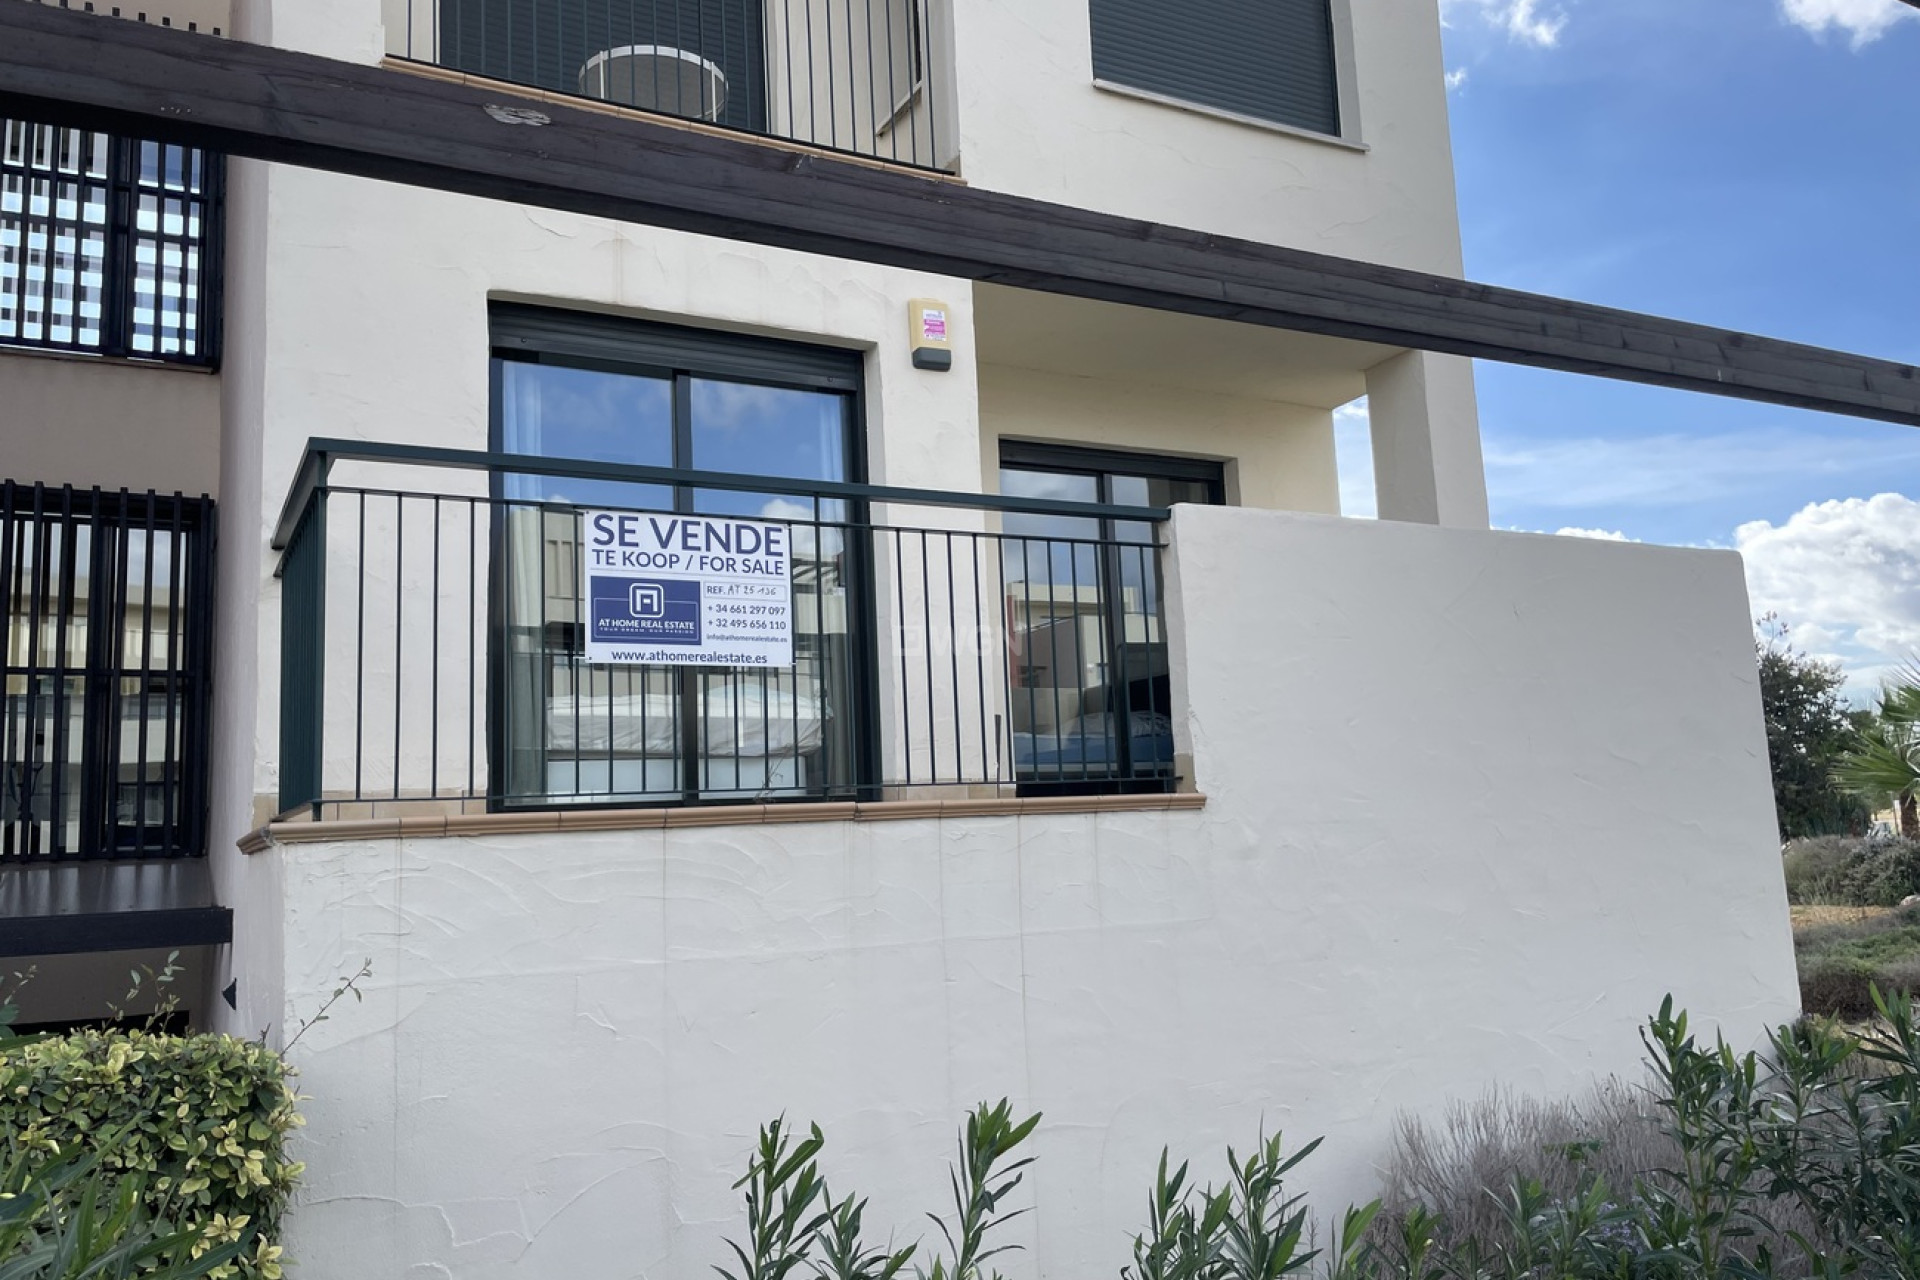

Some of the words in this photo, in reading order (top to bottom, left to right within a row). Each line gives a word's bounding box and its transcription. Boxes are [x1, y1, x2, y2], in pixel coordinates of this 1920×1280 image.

[593, 514, 639, 547] SE
[649, 518, 783, 557] VENDE
[592, 549, 616, 565] TE
[623, 551, 680, 568] KOOP
[685, 555, 693, 570] /
[700, 556, 737, 572] FOR
[742, 559, 784, 575] SALE
[707, 586, 725, 594] REF.
[716, 604, 727, 613] 34
[730, 605, 747, 614] 661
[750, 606, 766, 614] 297
[768, 607, 785, 615] 097
[612, 619, 639, 627] HOME
[641, 620, 663, 628] REAL
[665, 621, 694, 629] ESTATE
[716, 619, 727, 627] 32
[730, 620, 747, 628] 495
[750, 621, 766, 629] 656
[770, 621, 786, 629] 110
[611, 650, 767, 664] www.athomerealestate.es
